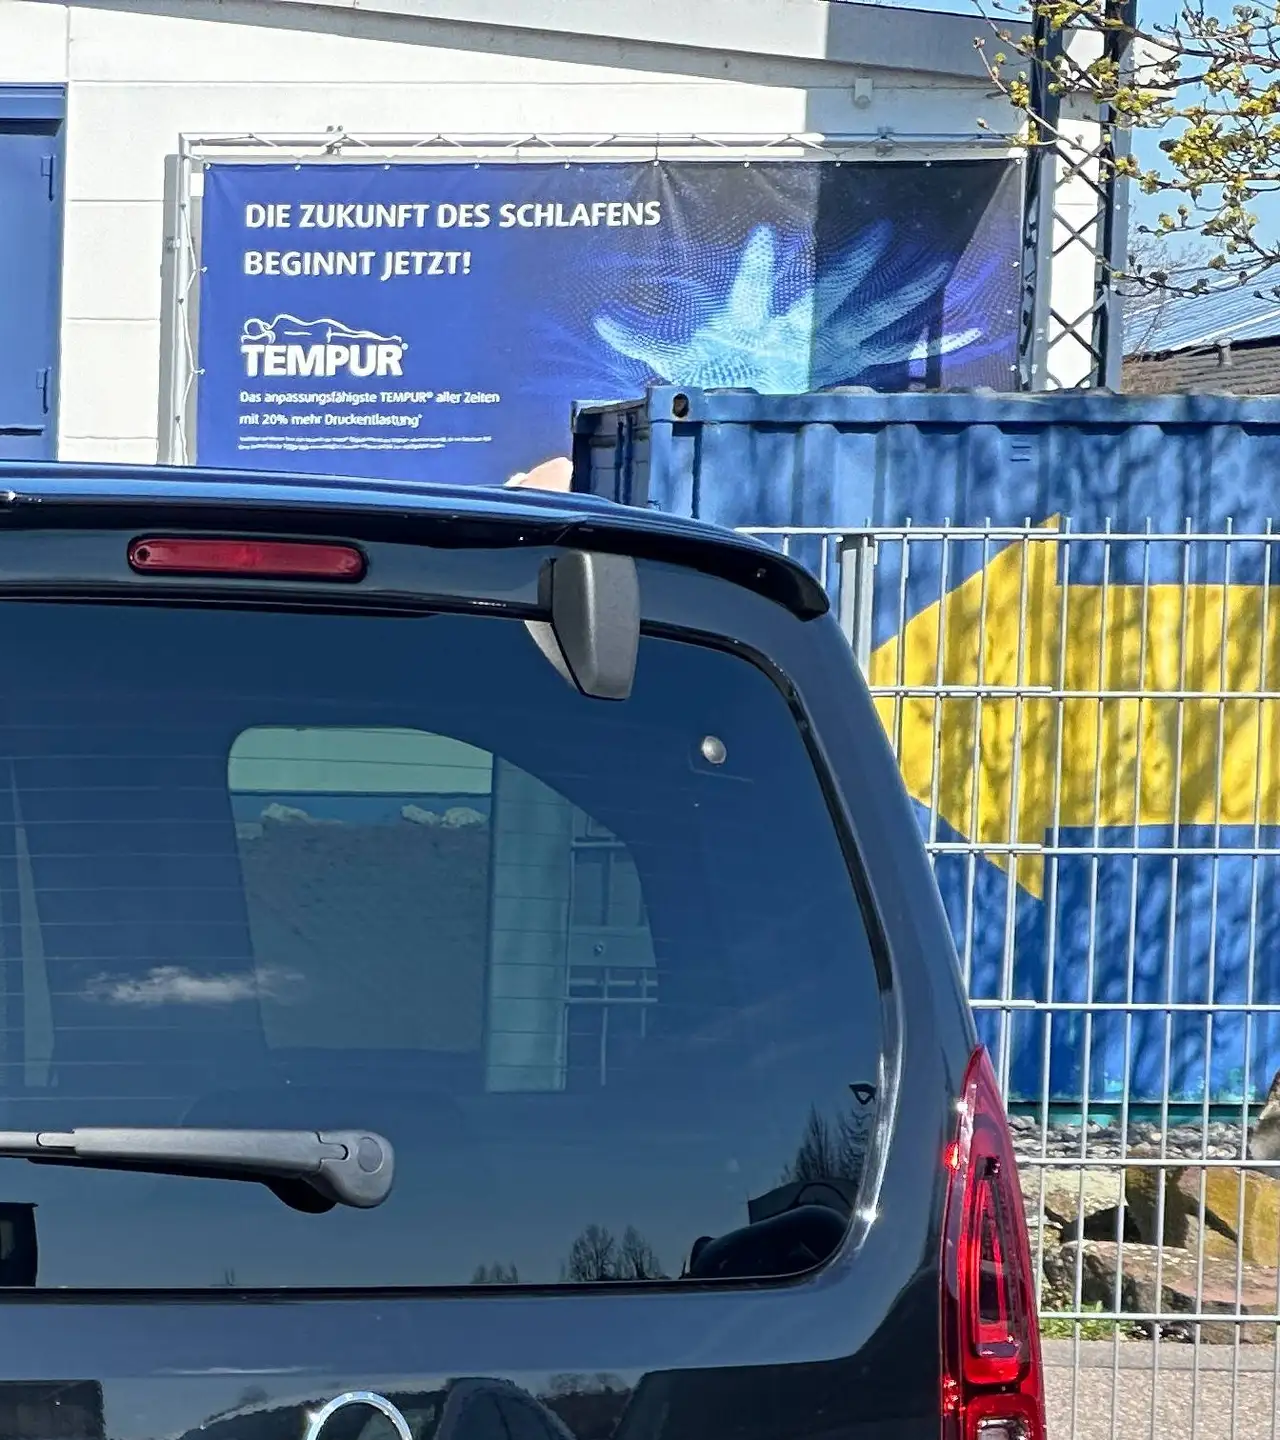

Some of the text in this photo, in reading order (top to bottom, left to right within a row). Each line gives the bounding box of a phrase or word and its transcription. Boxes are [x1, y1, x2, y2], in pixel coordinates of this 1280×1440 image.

[246, 201, 661, 228] DIE ZUKUNFT DES SCHLAFENS
[244, 251, 471, 282] BEGINNT JETZT!
[240, 391, 261, 403] Das
[265, 391, 377, 406] anpassungsfähigste
[437, 391, 462, 404] aller
[464, 391, 500, 404] Zeiten
[240, 414, 259, 425] mit
[262, 414, 288, 425] 20%
[292, 414, 322, 425] mehr
